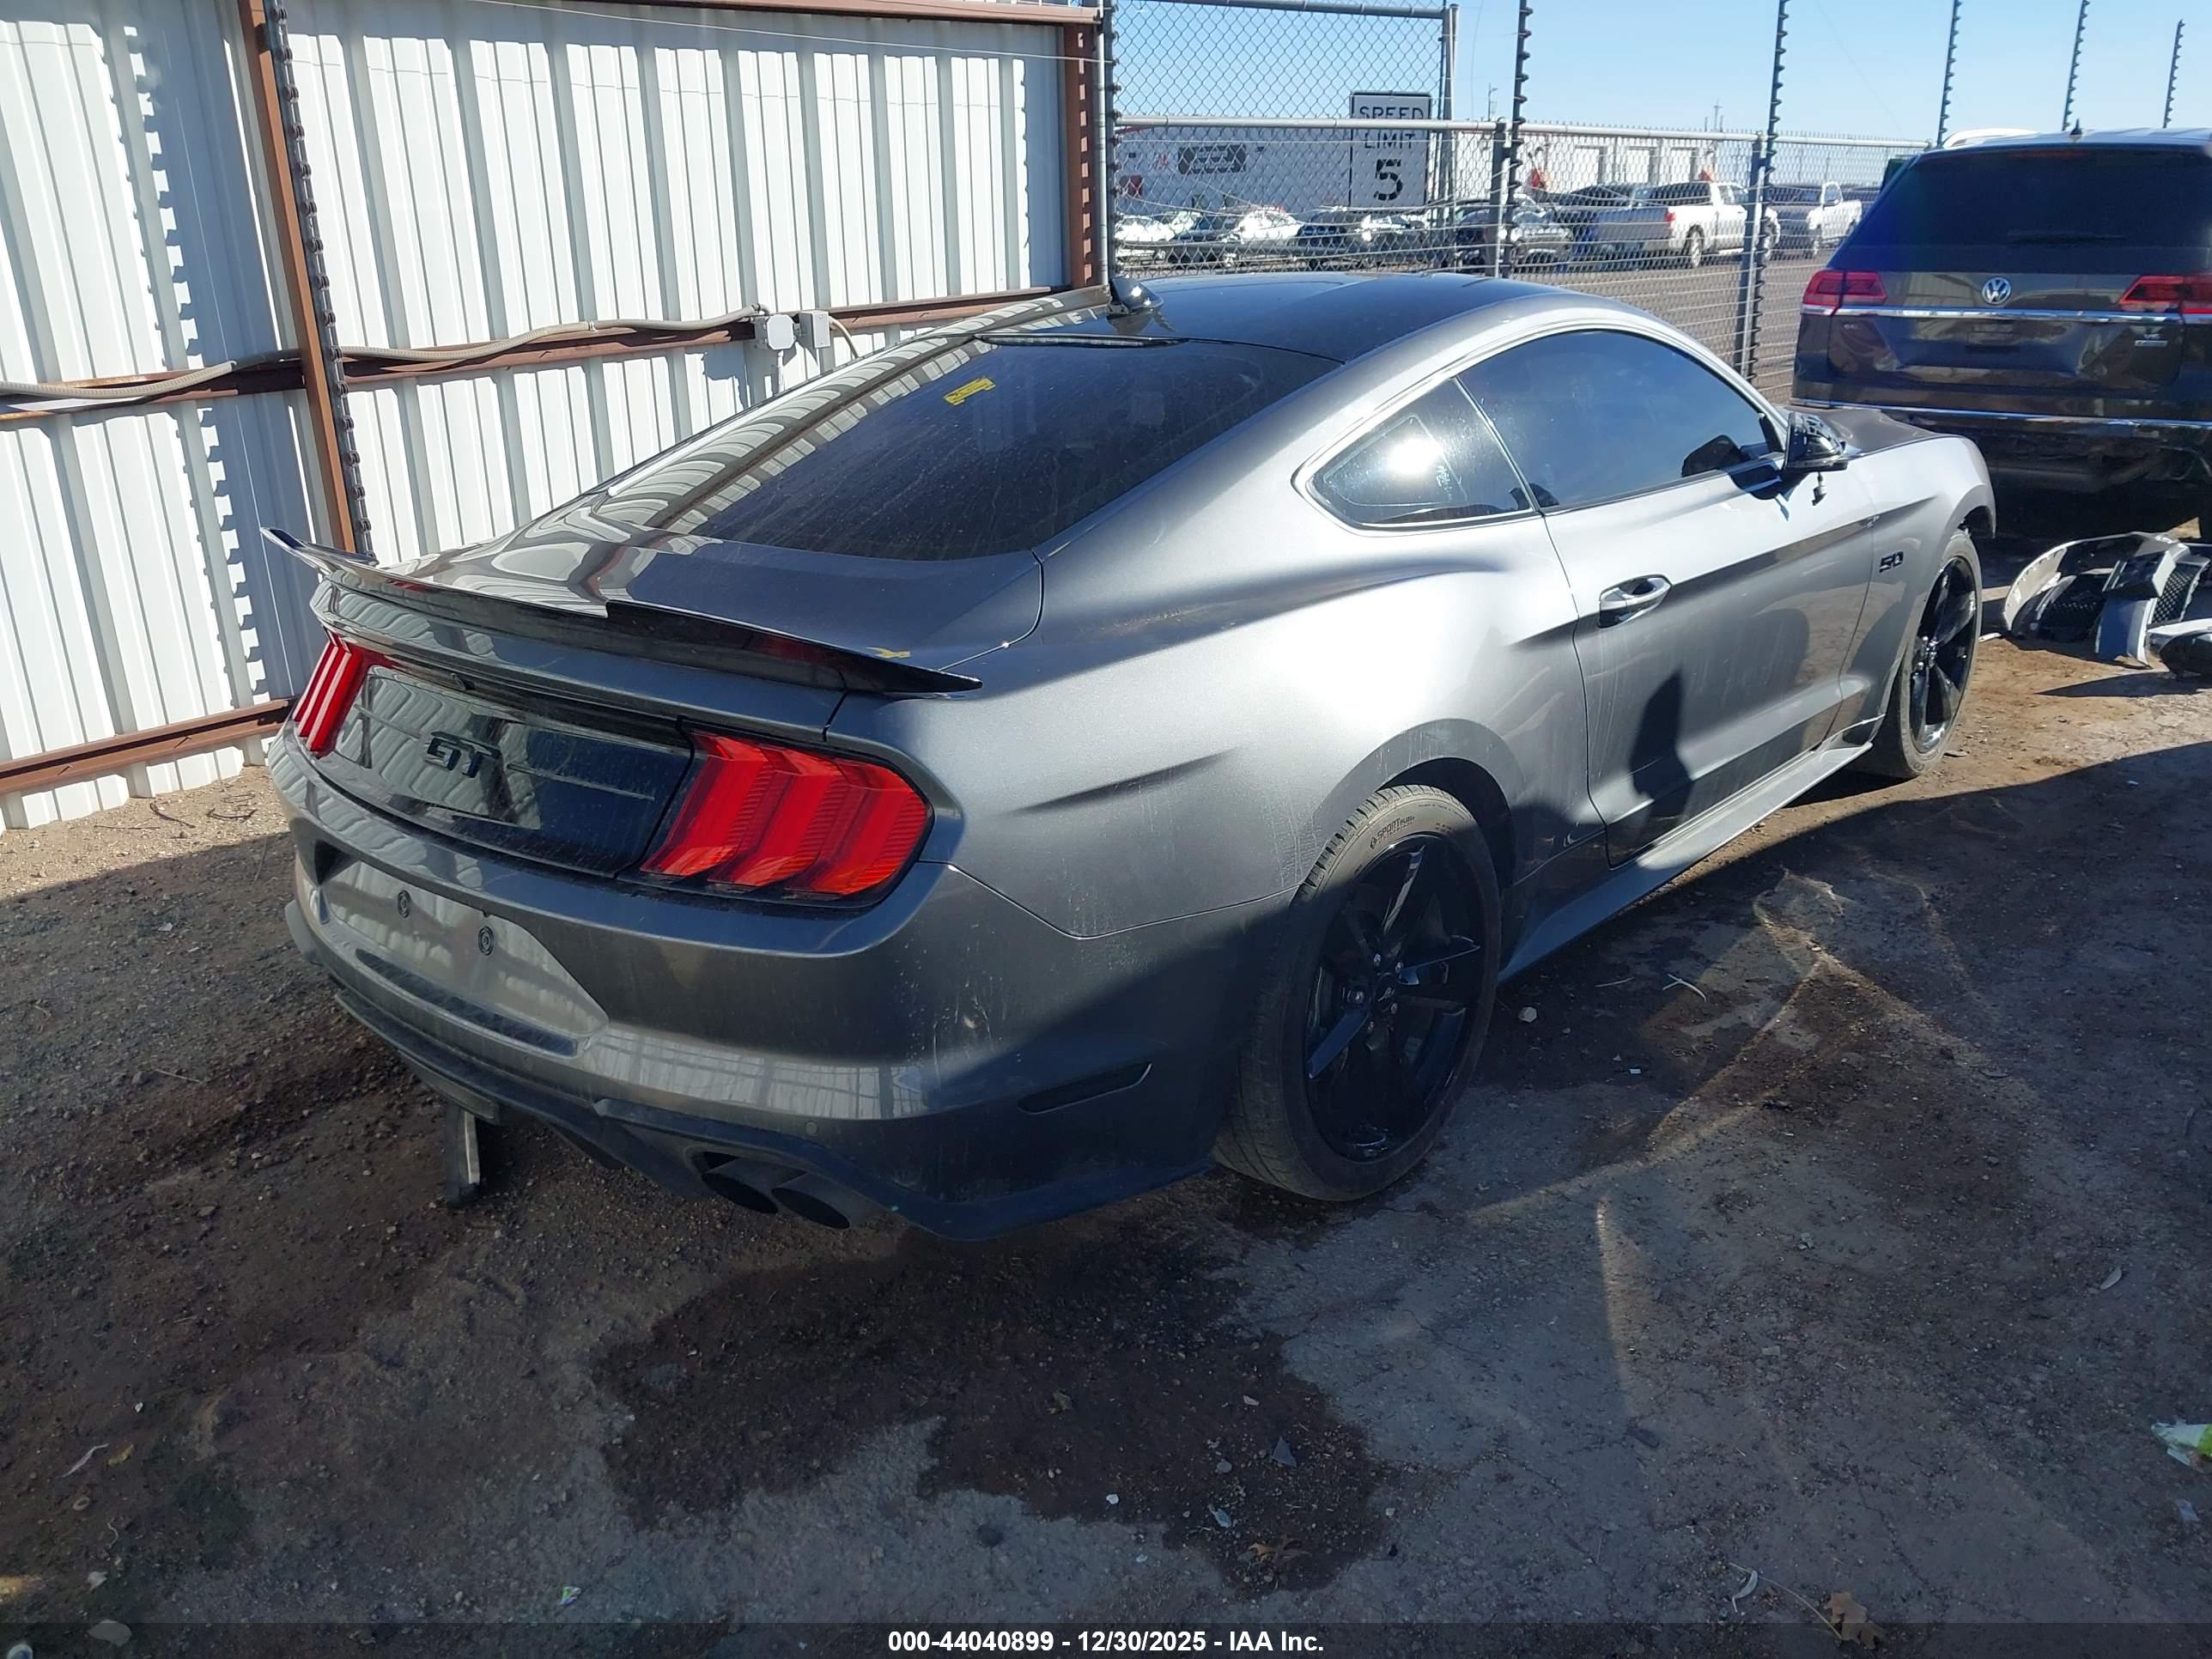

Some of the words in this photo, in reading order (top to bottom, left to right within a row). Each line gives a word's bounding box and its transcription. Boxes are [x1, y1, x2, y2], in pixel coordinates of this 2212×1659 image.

[1359, 106, 1425, 119] SPEED
[1364, 131, 1416, 149] LIMIT
[1374, 158, 1403, 201] 5
[427, 731, 502, 779] GT
